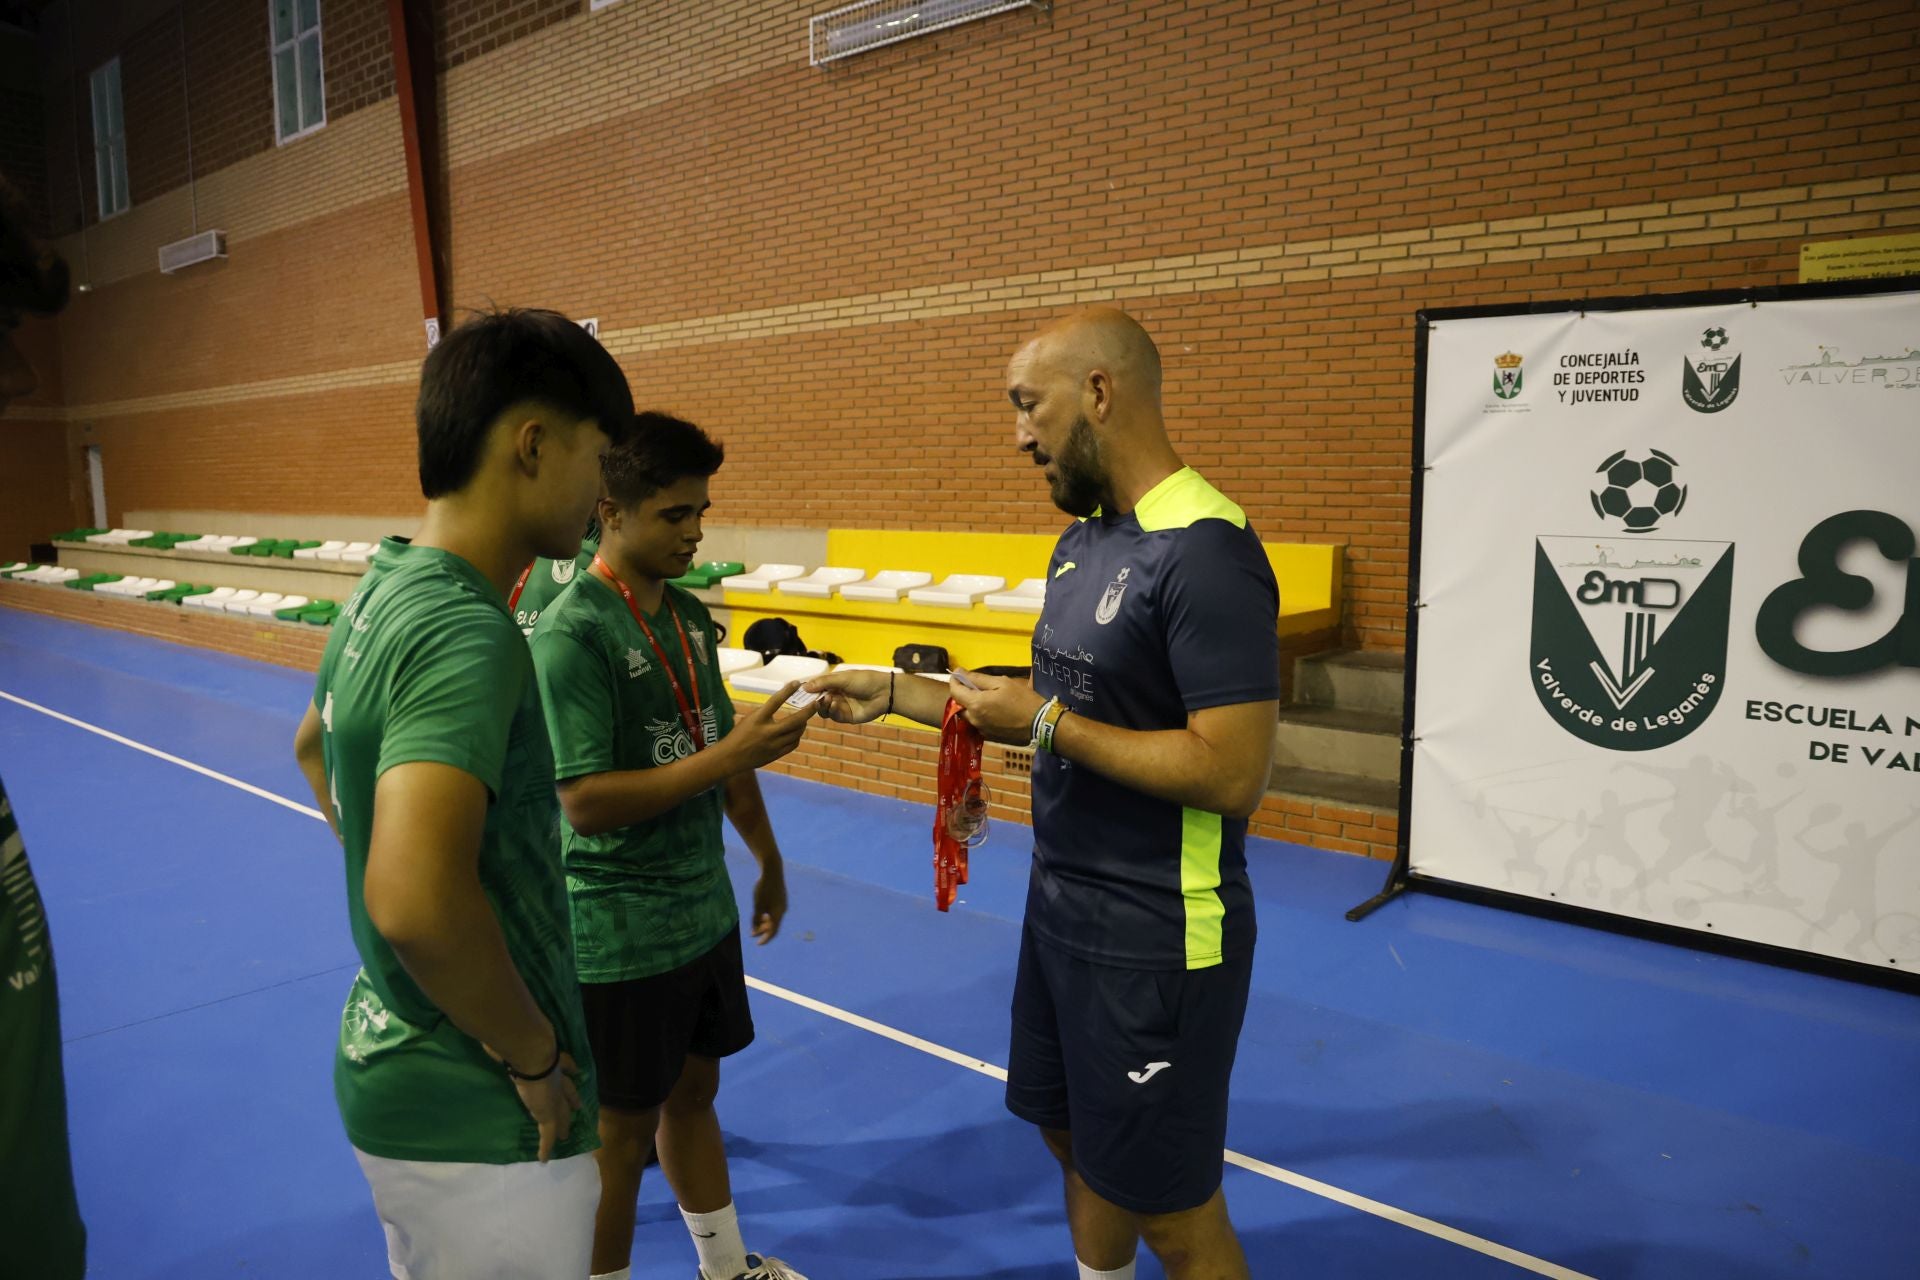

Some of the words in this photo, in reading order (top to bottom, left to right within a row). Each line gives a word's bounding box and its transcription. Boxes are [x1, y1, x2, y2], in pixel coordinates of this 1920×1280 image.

[1560, 349, 1640, 369] CONCEJALÍA
[1553, 373, 1571, 386] DE
[1575, 370, 1645, 385] DEPORTES
[1558, 390, 1567, 403] Y
[1570, 388, 1640, 406] JUVENTUD
[1537, 658, 1604, 726] Valverde
[1611, 718, 1638, 731] de
[1643, 673, 1716, 730] Leganés
[1745, 700, 1893, 735] ESCUELA
[1809, 741, 1849, 763] DE
